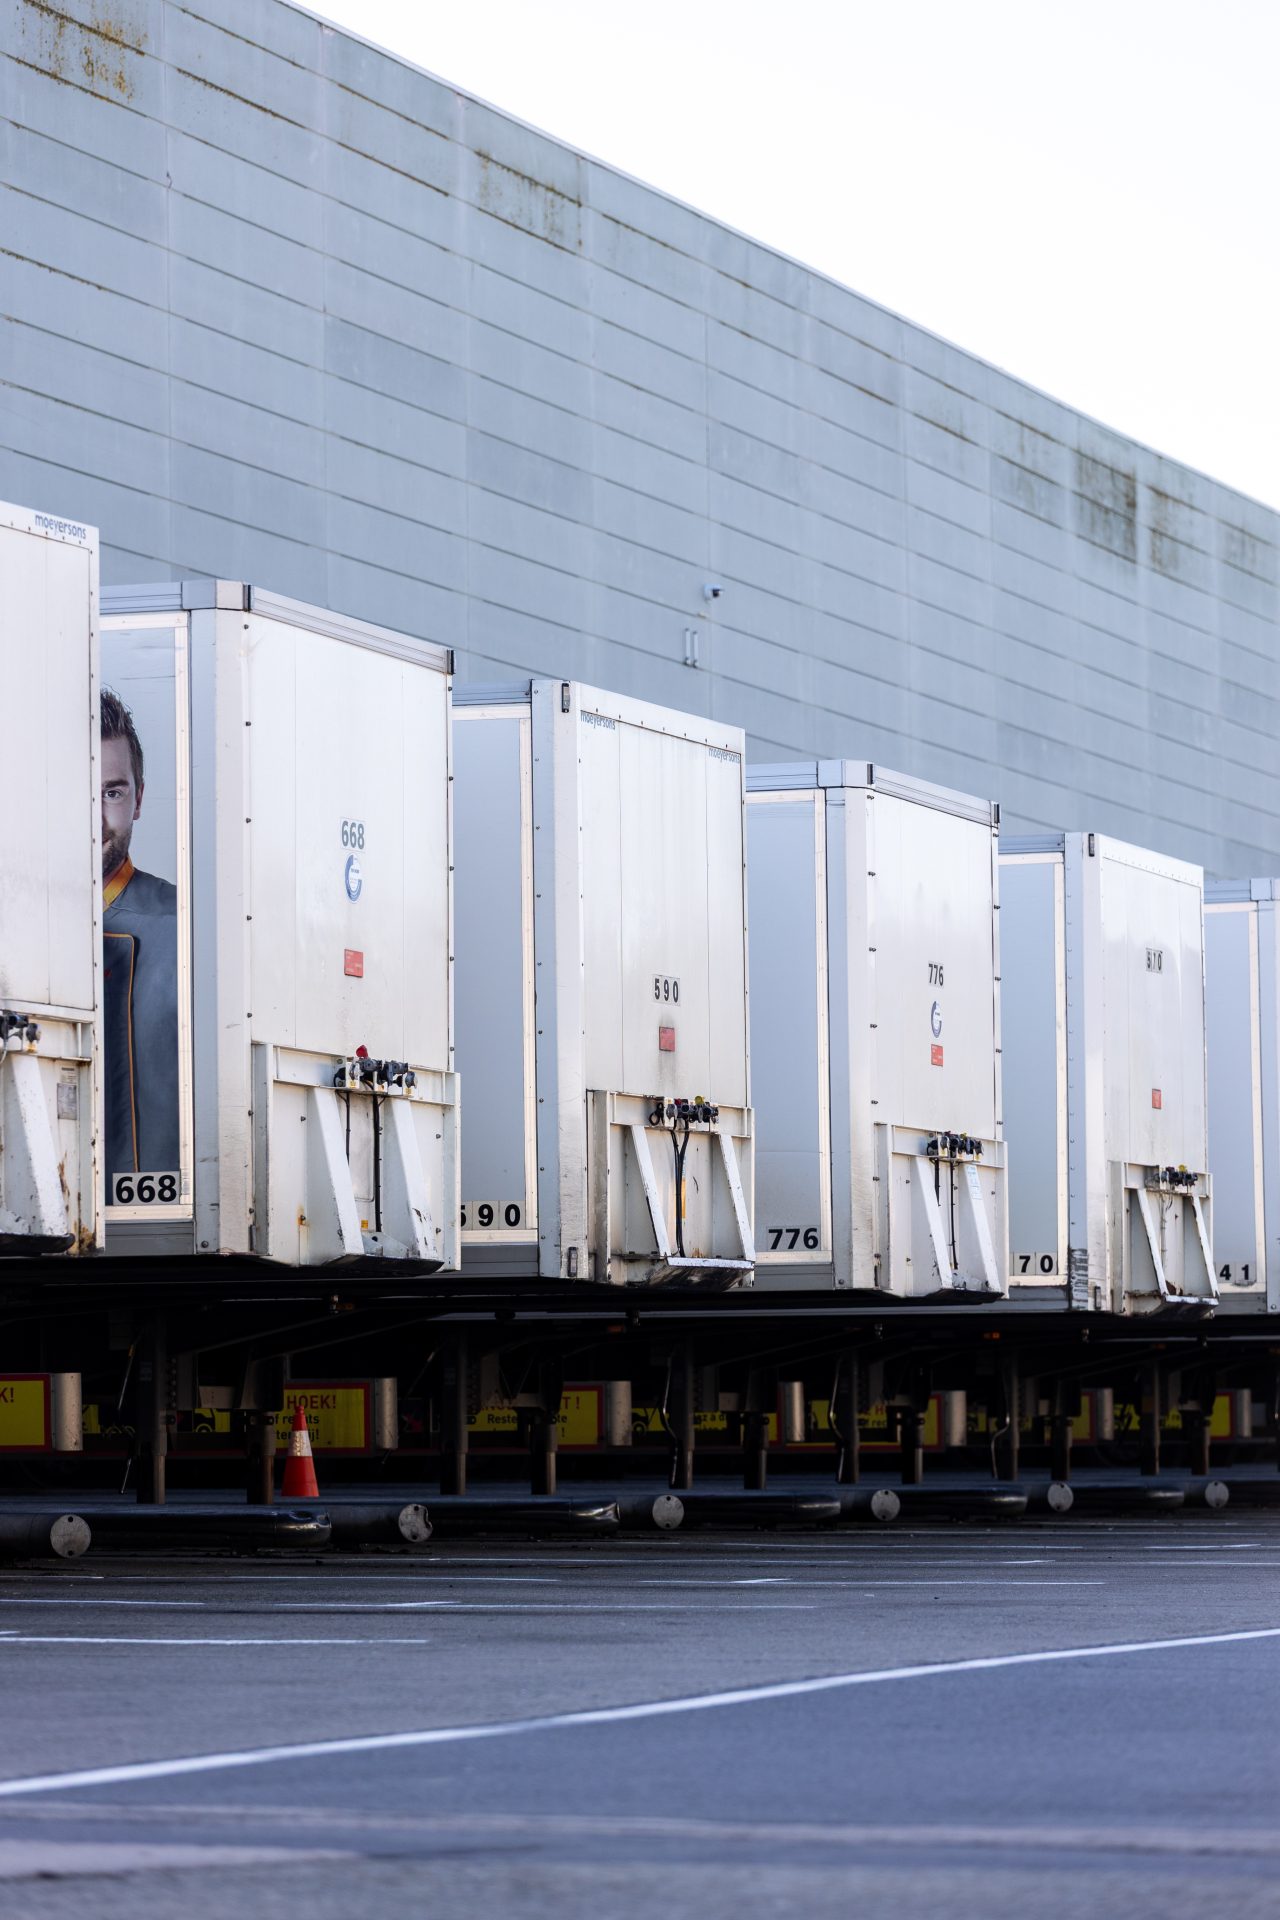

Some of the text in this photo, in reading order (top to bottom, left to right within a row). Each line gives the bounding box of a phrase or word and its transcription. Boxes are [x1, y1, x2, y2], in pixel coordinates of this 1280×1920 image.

[34, 514, 87, 539] moeyersons
[341, 820, 365, 850] 668
[928, 963, 944, 986] 776
[654, 977, 679, 1003] 590
[115, 1174, 177, 1204] 668
[768, 1227, 819, 1250] 776
